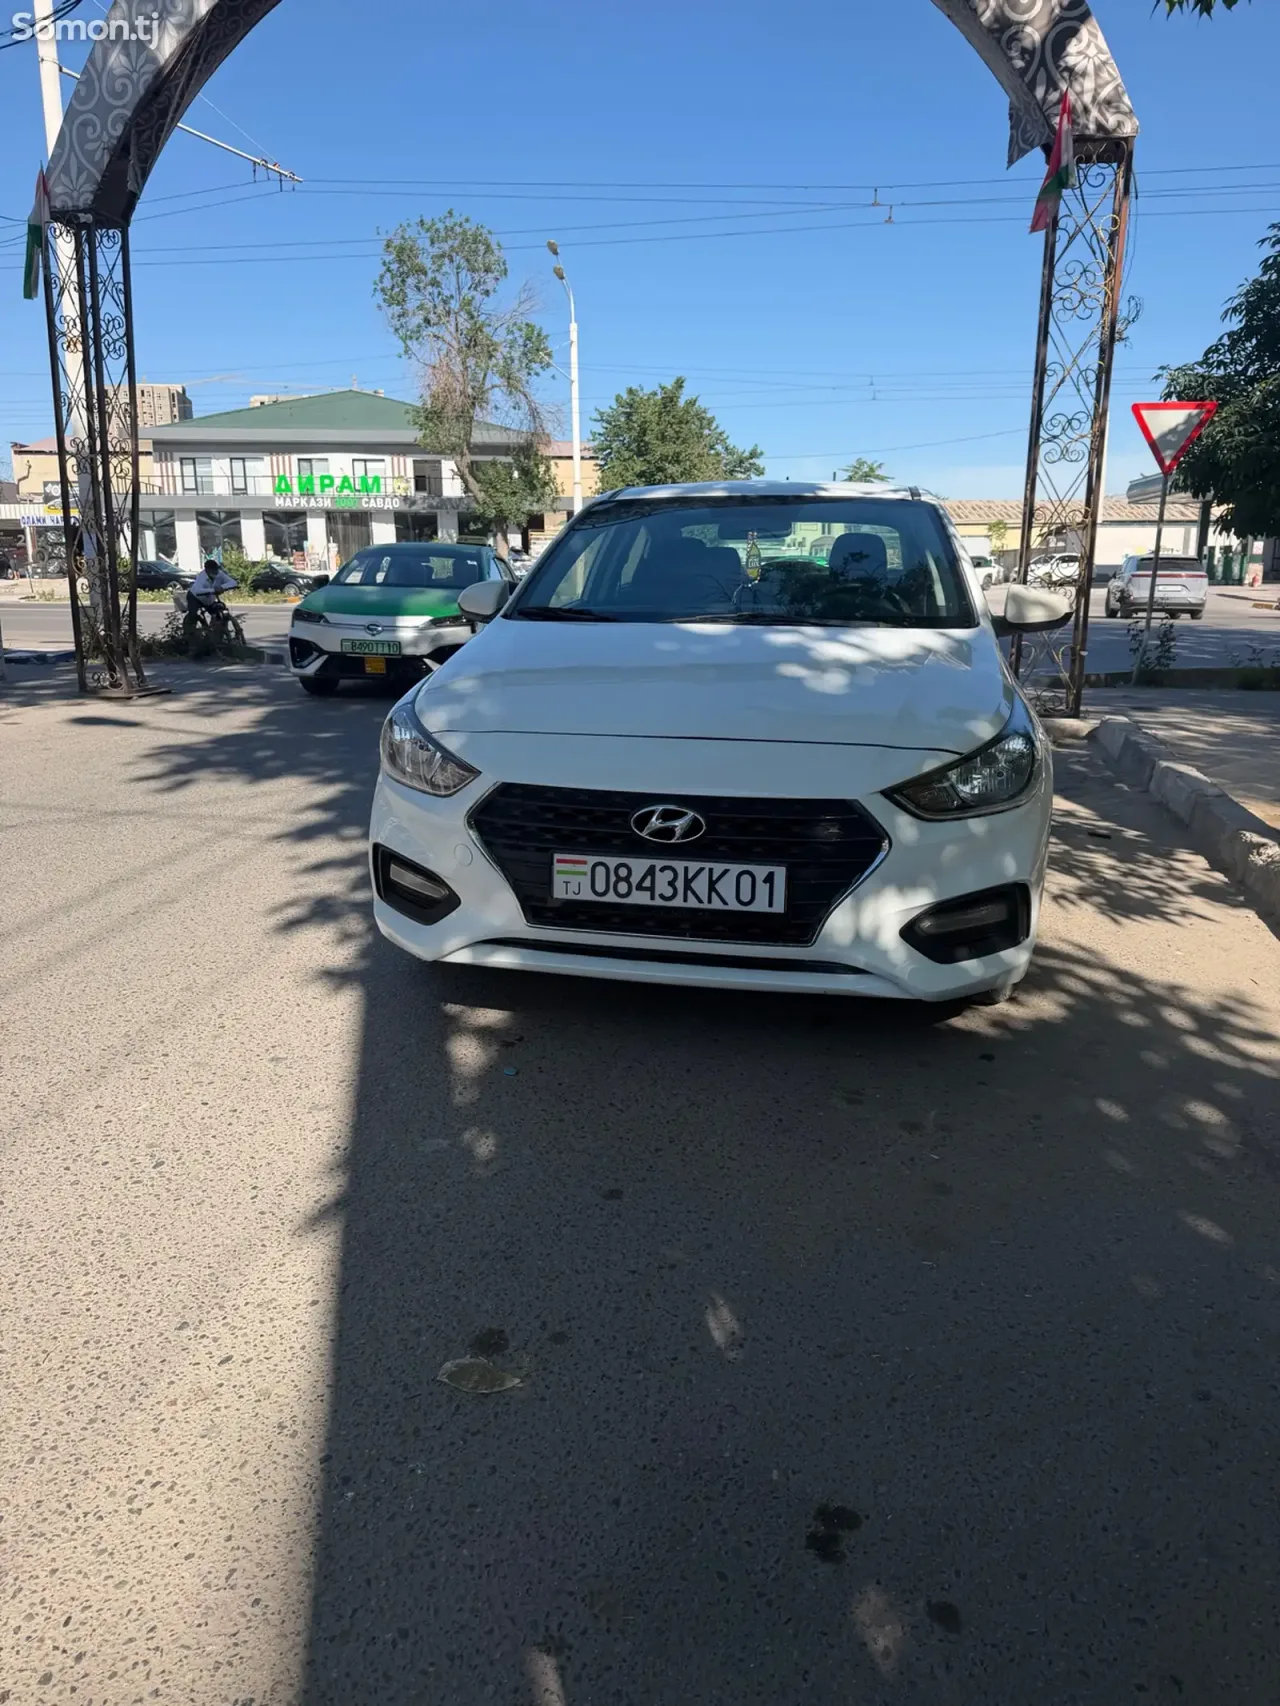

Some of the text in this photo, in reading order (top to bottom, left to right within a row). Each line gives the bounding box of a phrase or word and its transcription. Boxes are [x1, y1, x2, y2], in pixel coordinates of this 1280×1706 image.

[275, 474, 381, 493] ДИРАМ
[275, 497, 331, 508] МАРКАЗИ
[362, 497, 400, 510] САВДО
[563, 881, 581, 896] TJ
[590, 861, 775, 908] 0843KK01
